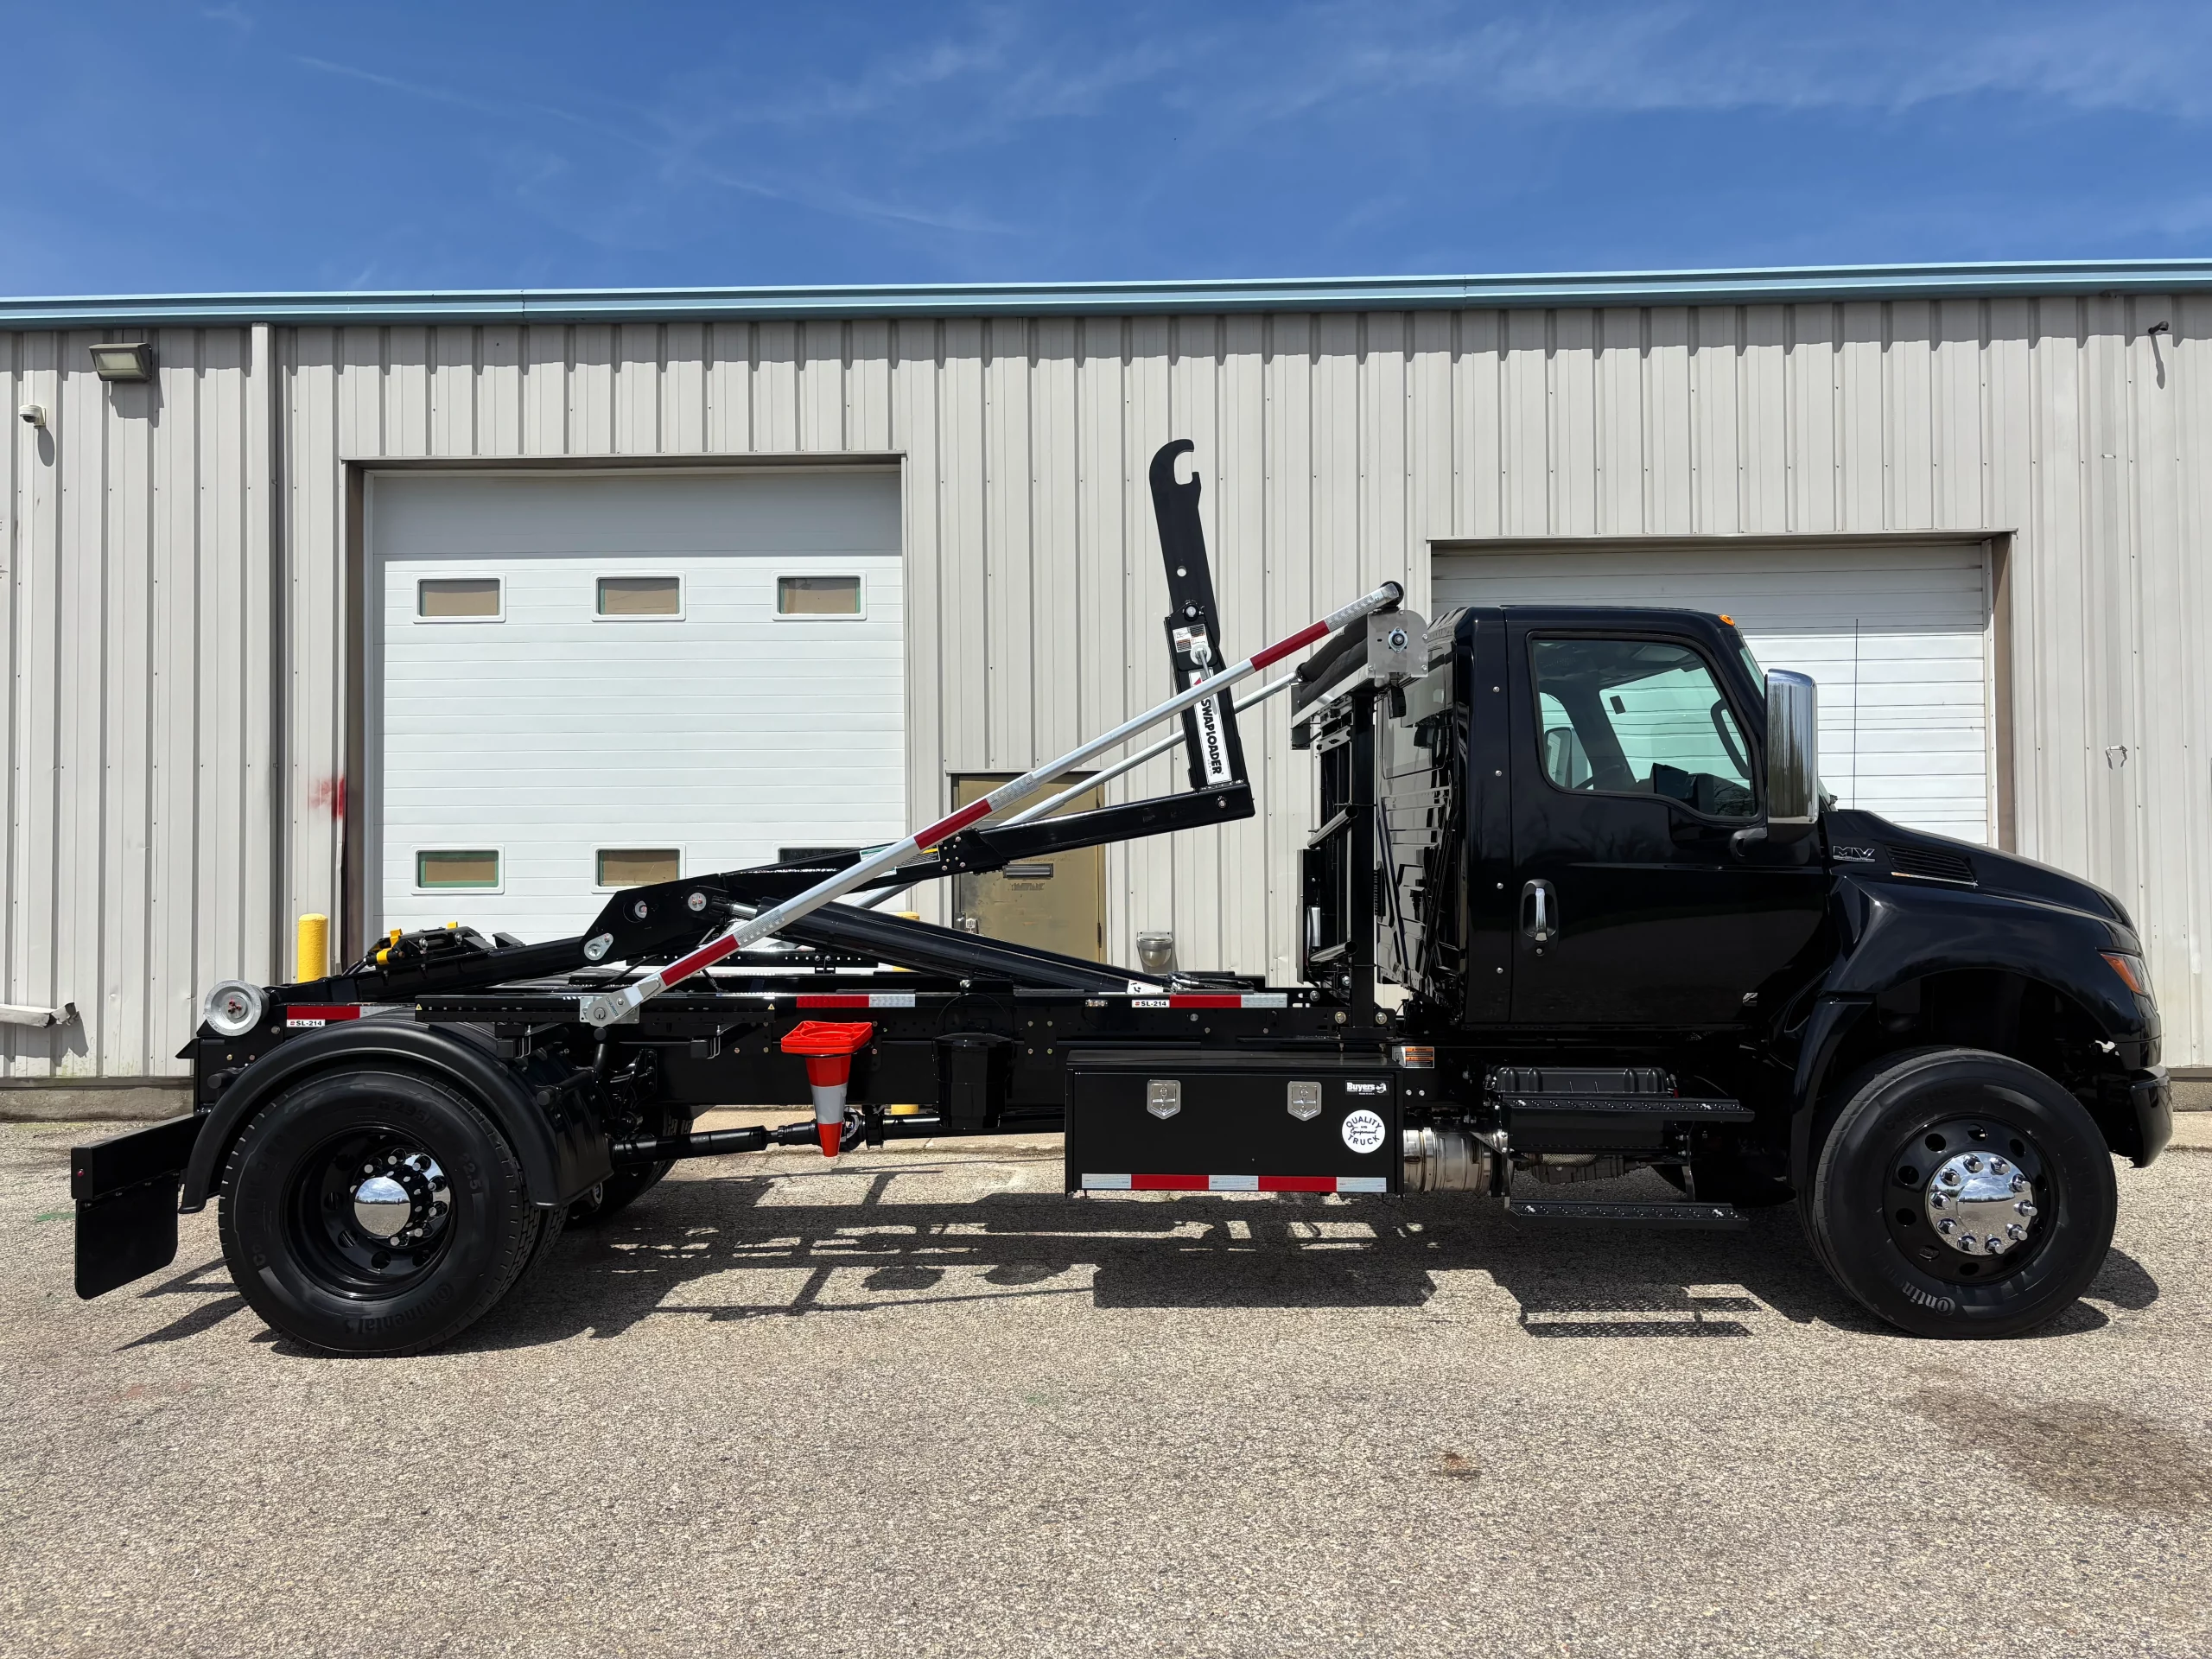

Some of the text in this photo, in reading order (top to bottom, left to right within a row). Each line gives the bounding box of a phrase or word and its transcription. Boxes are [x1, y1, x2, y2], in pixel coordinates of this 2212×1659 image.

[1833, 845, 1875, 859] MV
[1346, 1082, 1376, 1092] Buyers
[1345, 1116, 1382, 1128] QUALITY
[1348, 1134, 1381, 1146] TRUCK
